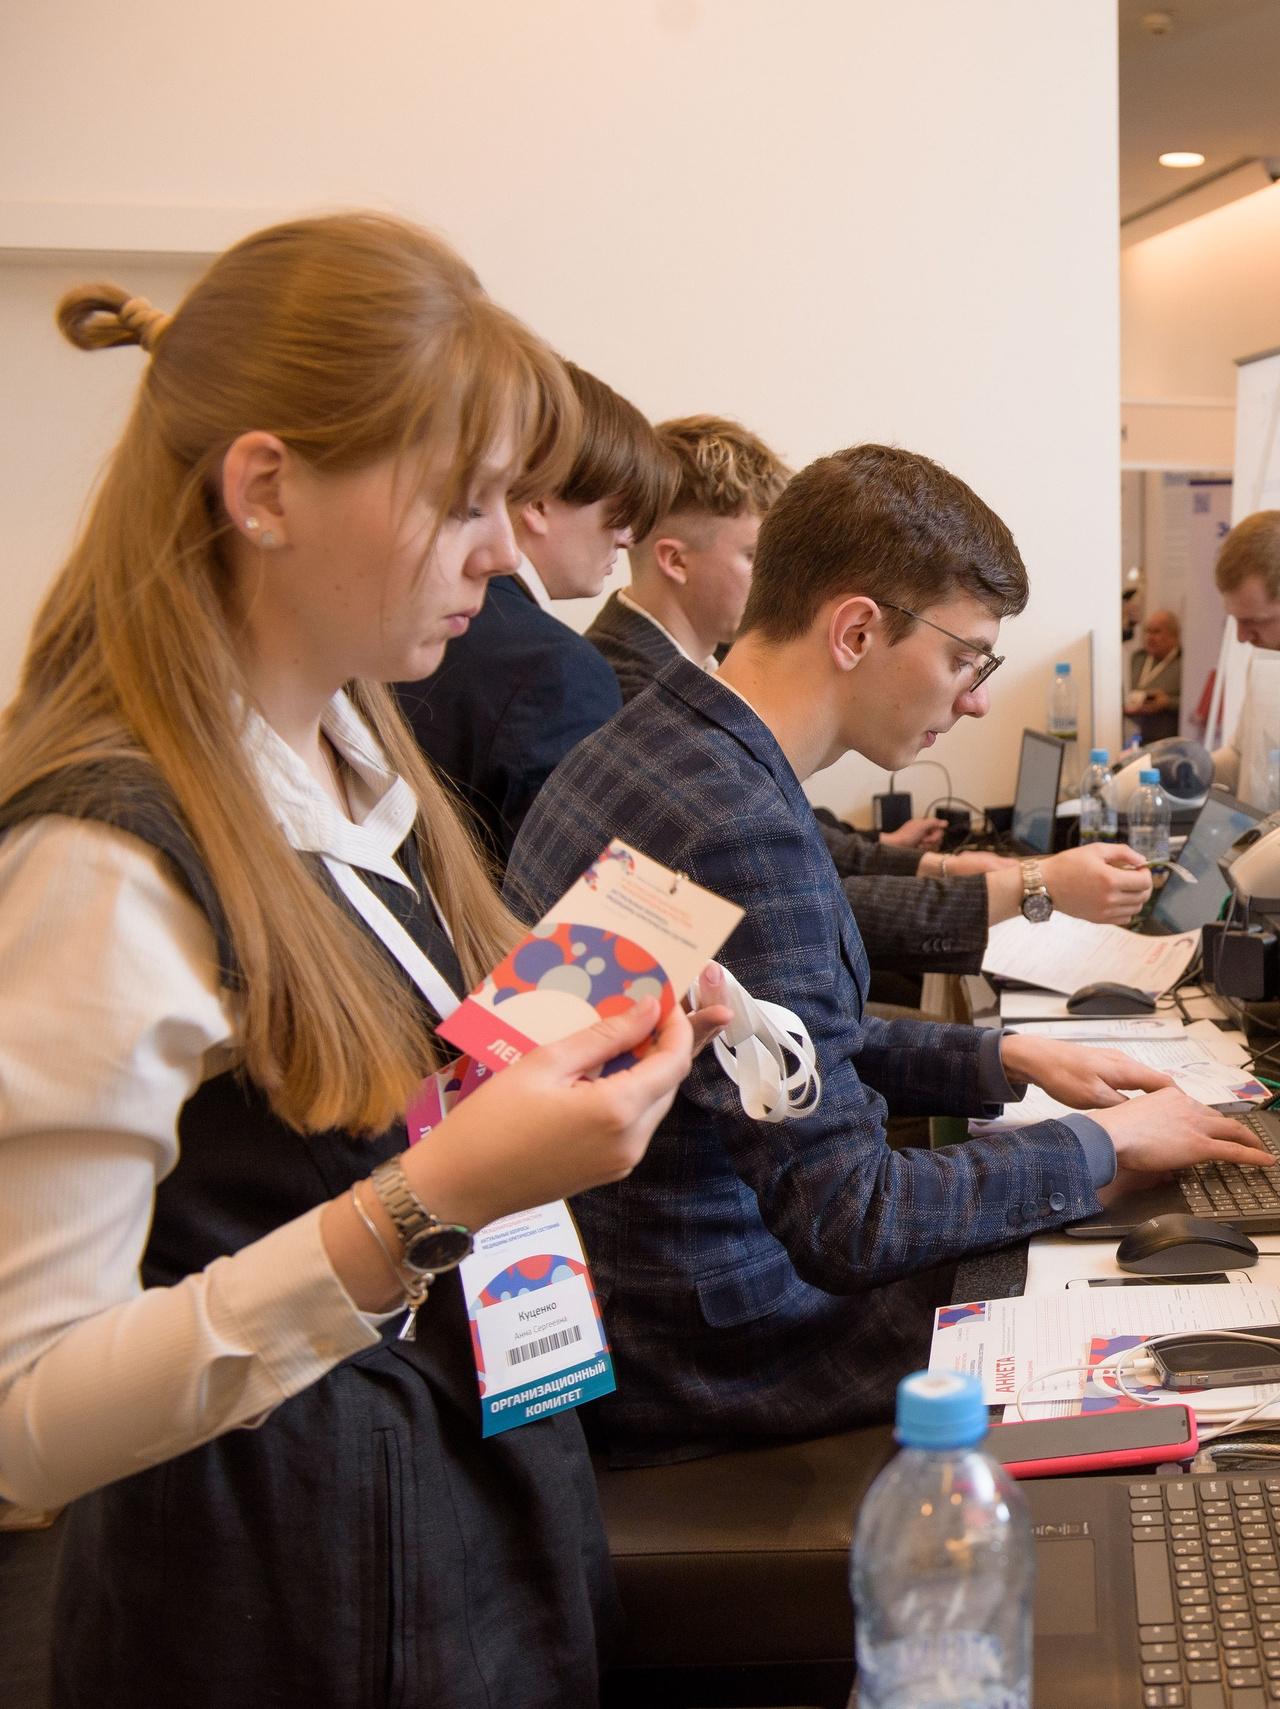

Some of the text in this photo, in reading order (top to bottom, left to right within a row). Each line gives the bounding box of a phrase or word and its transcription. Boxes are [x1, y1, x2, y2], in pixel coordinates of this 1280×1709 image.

[510, 1225, 530, 1236] ВОПРОСЫ
[518, 1302, 557, 1322] Куценко
[514, 1315, 568, 1340] Анна Сергеевна
[490, 1359, 606, 1414] ОРГАНИЗАЦИОННЫЙ
[995, 1356, 1016, 1393] АНКЕТА
[525, 1387, 582, 1418] КОМИТЕТ
